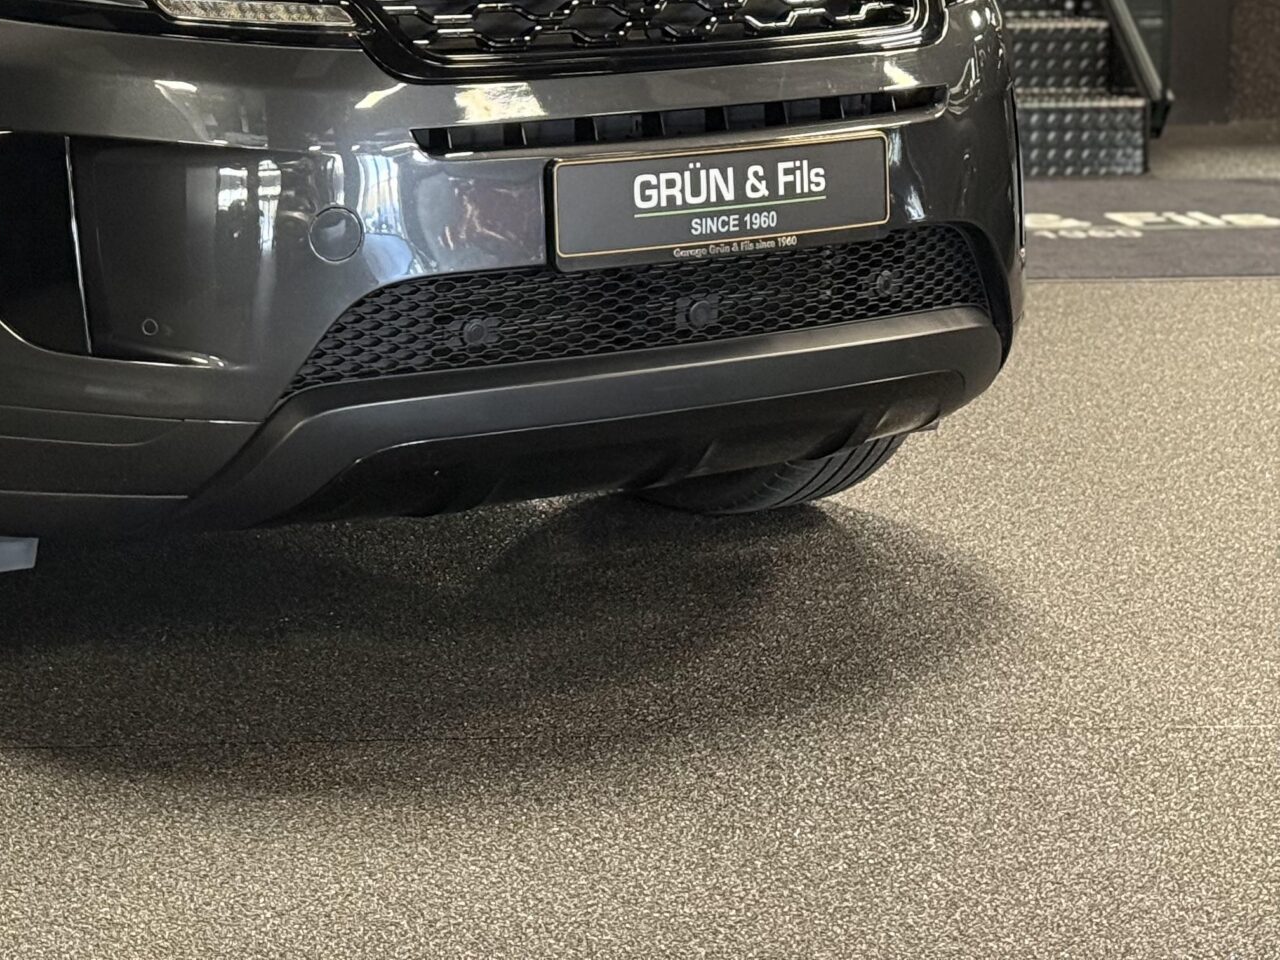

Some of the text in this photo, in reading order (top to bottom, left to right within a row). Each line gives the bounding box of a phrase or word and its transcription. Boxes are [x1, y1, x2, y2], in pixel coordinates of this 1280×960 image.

[633, 159, 826, 209] GRÜN & Fils
[690, 211, 777, 236] SINCE 1960
[673, 236, 798, 258] Garage Grün & Fils since 1960
